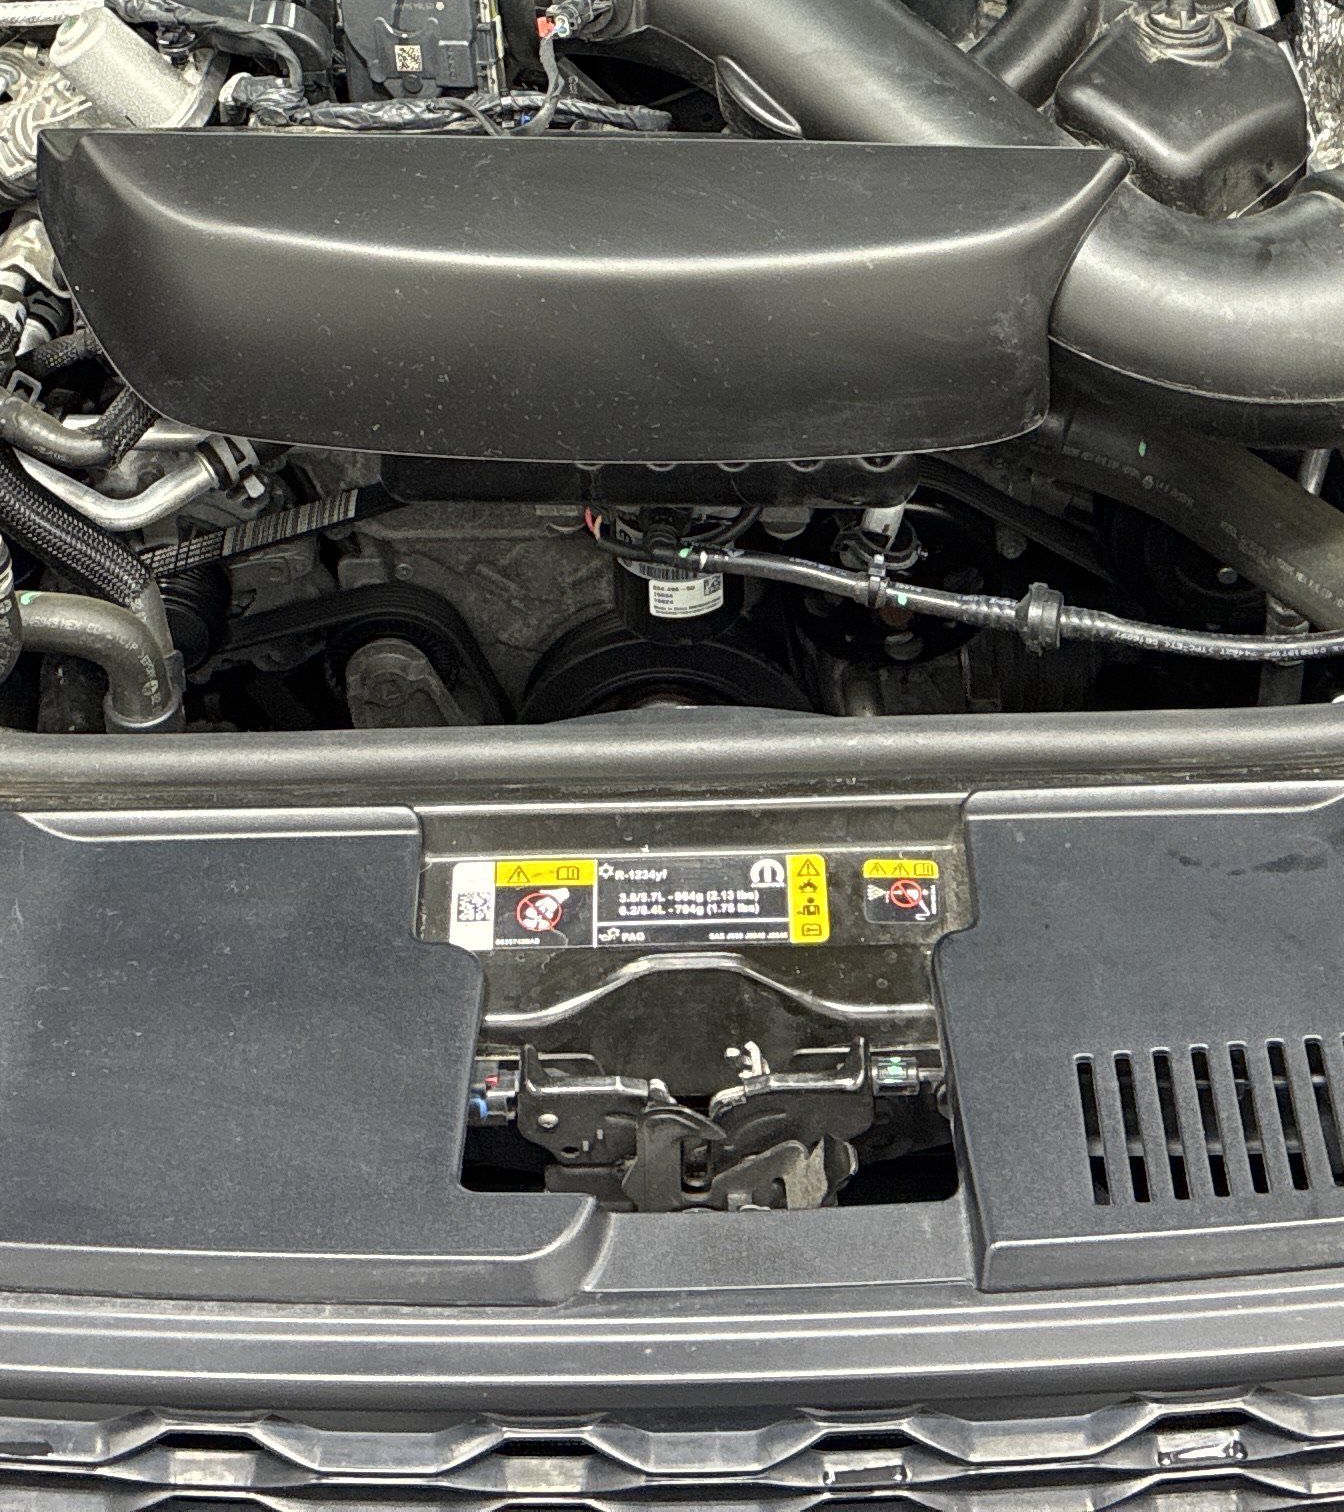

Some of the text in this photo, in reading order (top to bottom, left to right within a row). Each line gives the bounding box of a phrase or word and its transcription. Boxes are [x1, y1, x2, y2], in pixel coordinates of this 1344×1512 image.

[614, 869, 668, 882] R-1234yf
[706, 890, 736, 903] (2.13
[621, 932, 645, 942] PAG
